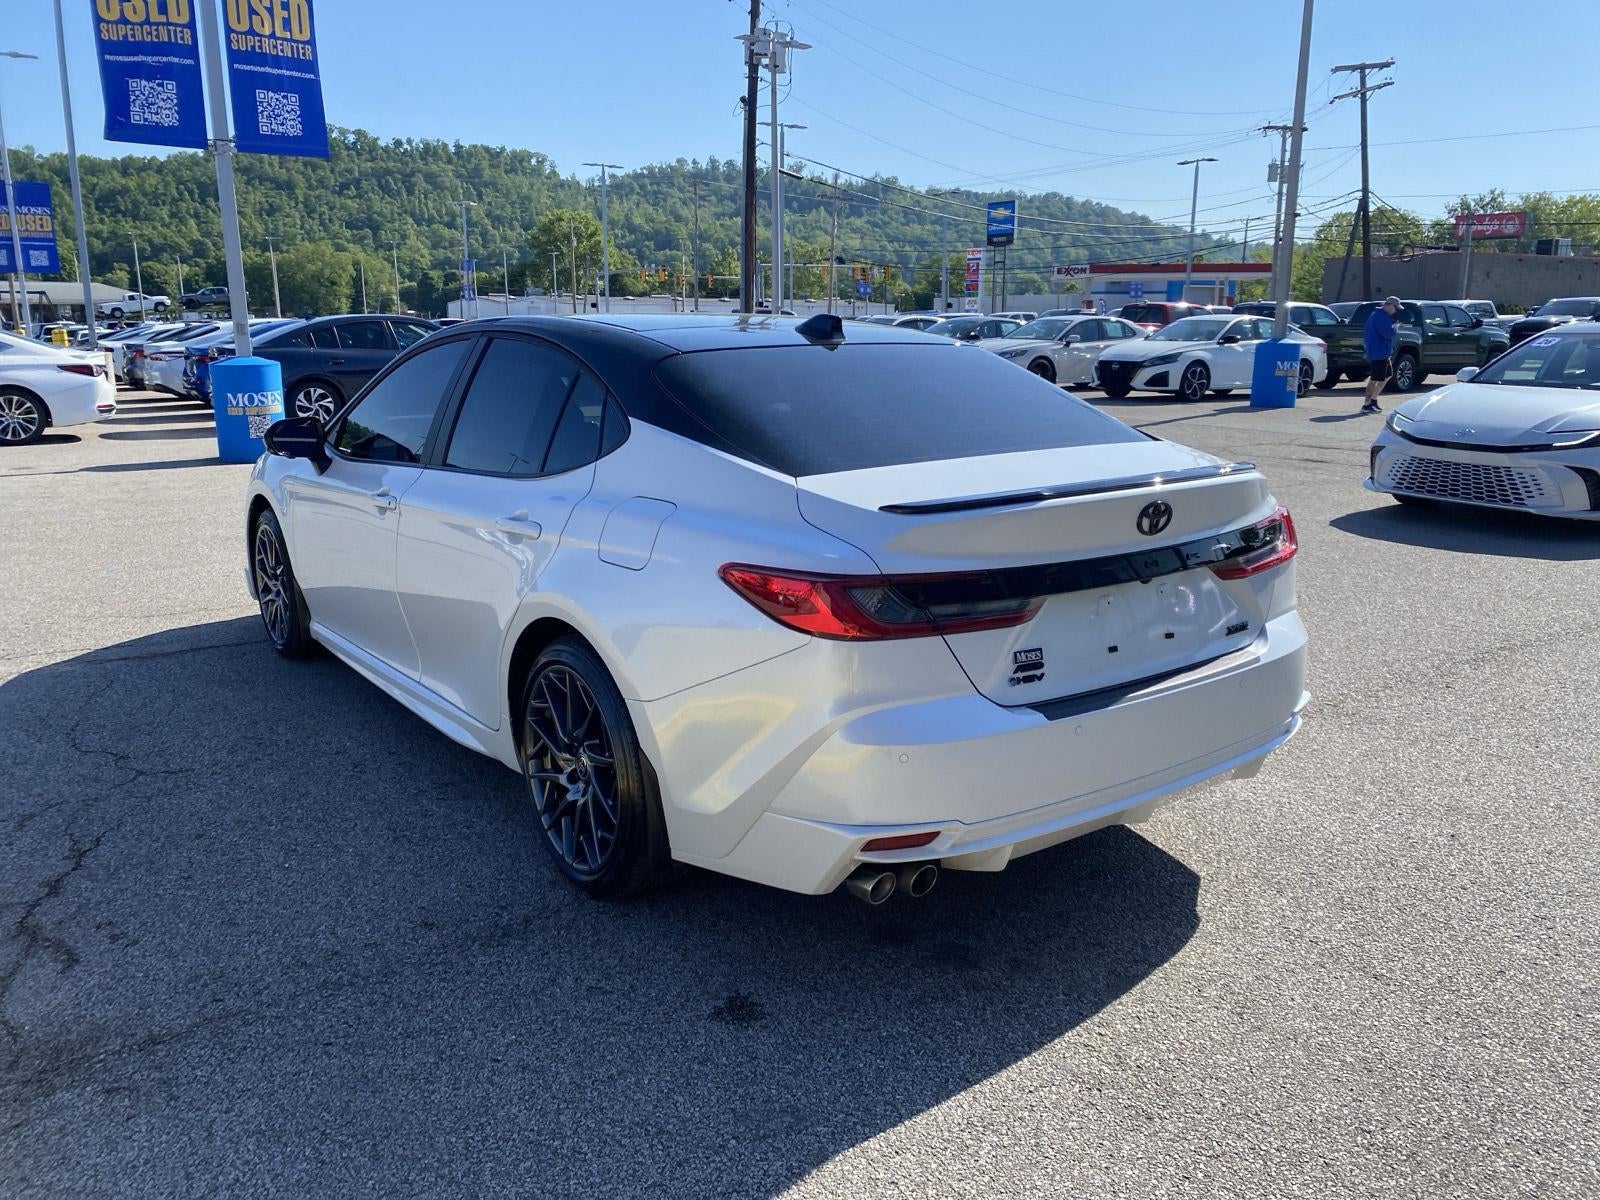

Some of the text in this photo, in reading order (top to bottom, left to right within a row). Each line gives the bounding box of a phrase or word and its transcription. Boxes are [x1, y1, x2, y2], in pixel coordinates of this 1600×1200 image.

[227, 0, 310, 41] USED
[101, 22, 192, 45] SUPERCENTER
[231, 34, 312, 60] SUPERCENTER
[233, 63, 315, 79] mosesusedsupercenter.com
[15, 205, 51, 215] MOSES
[17, 214, 52, 231] USED
[1056, 266, 1087, 277] EXXON
[227, 391, 282, 407] MOSES
[1016, 650, 1042, 663] MOSES
